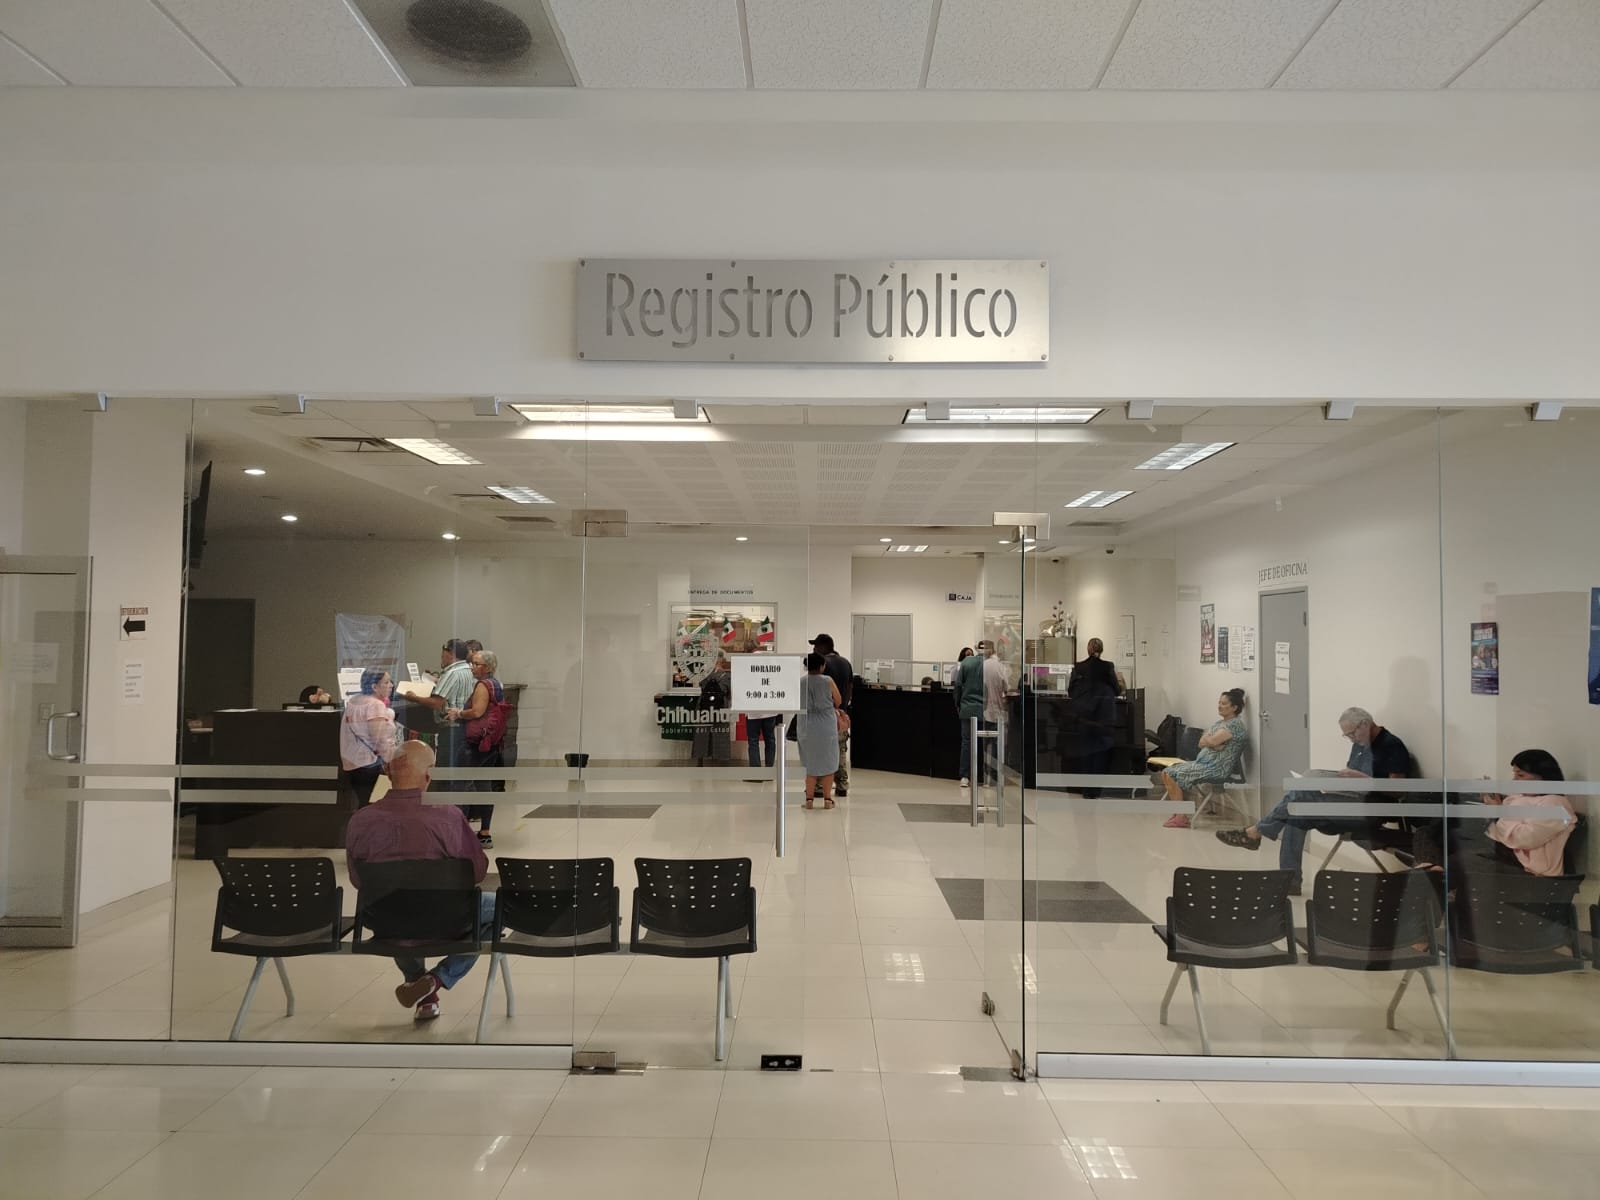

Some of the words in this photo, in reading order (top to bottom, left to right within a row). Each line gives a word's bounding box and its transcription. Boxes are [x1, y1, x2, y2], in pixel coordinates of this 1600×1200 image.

[606, 272, 813, 348] Registro
[833, 273, 1018, 339] Público
[750, 664, 782, 673] HORARIO
[761, 677, 771, 686] DE
[746, 690, 762, 699] 9:00
[769, 690, 786, 699] 3:00
